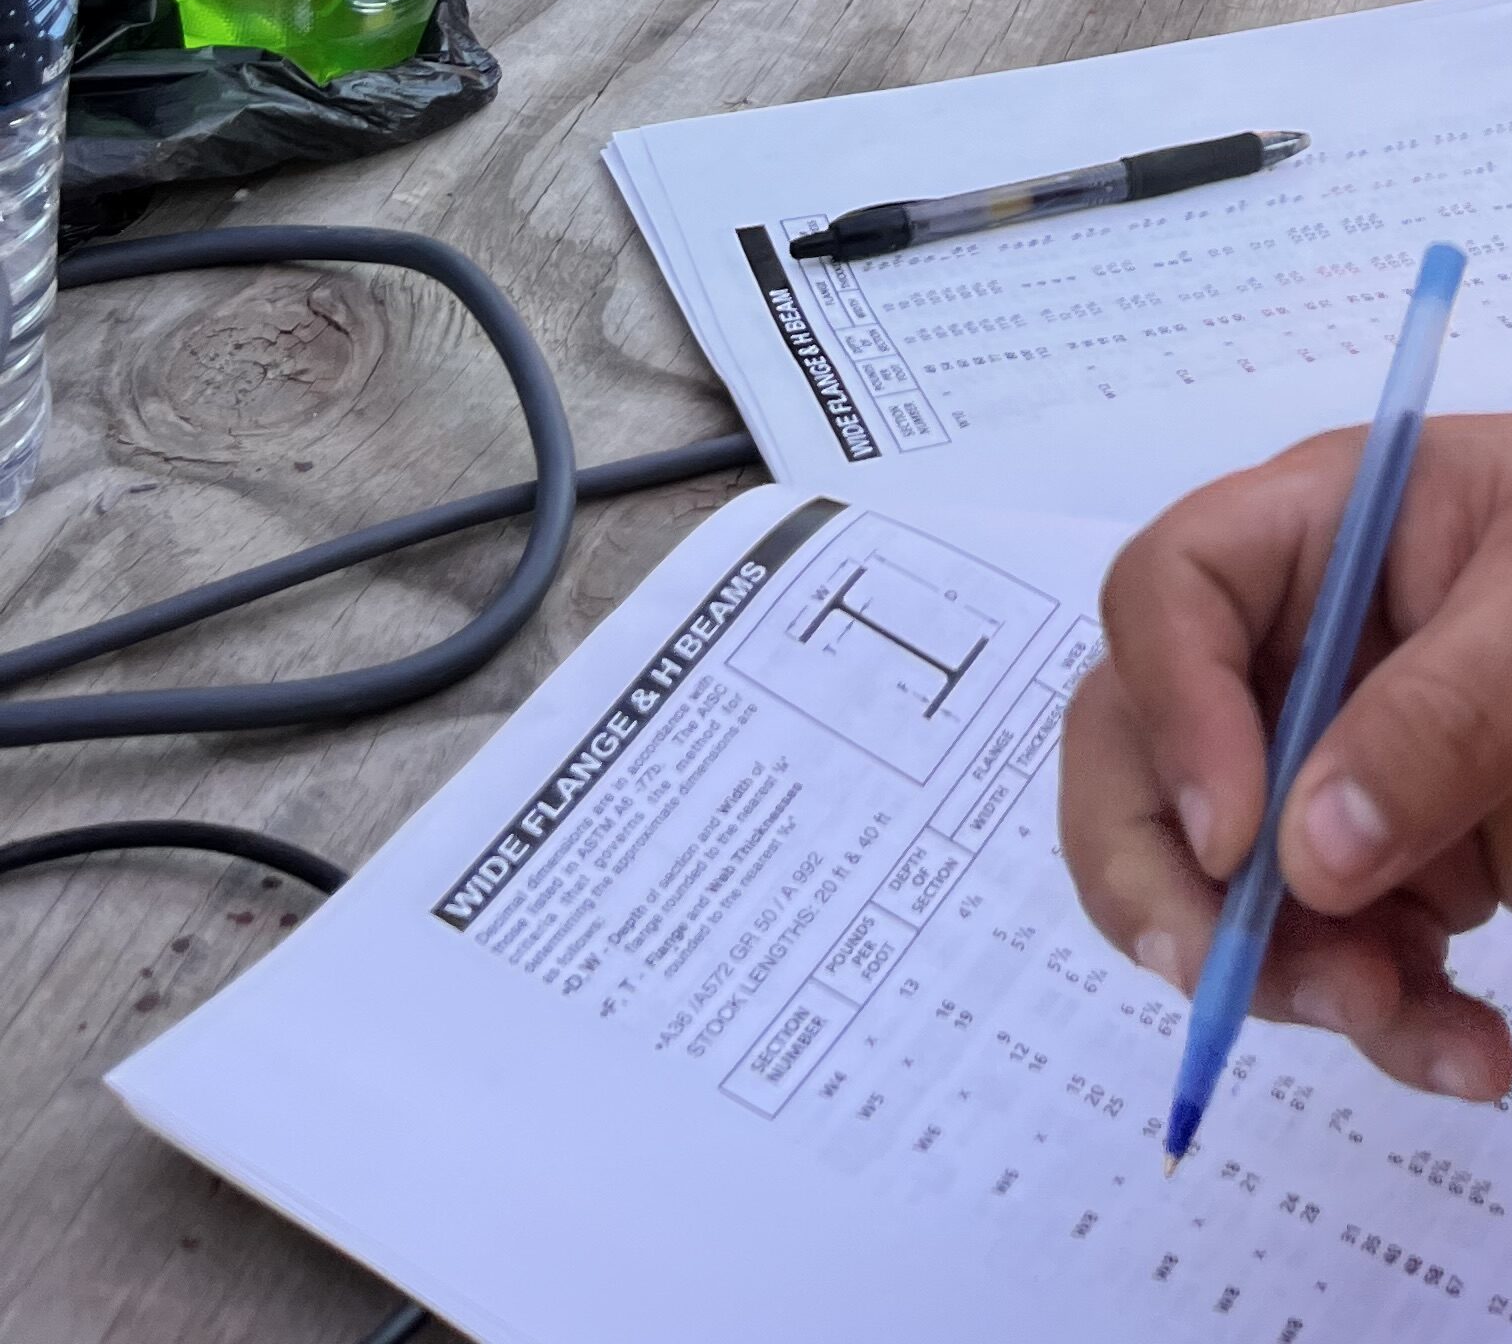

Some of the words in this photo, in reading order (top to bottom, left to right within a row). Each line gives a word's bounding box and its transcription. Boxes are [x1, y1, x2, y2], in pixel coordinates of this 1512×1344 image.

[769, 288, 806, 333] BEAM
[790, 332, 813, 344] H
[798, 344, 819, 357] &
[805, 355, 853, 415] FLANGE
[835, 414, 873, 459] WIDE
[445, 833, 530, 919] WIDE
[522, 710, 638, 836] FLANGE
[630, 689, 660, 713] &
[650, 657, 683, 686] H
[675, 560, 768, 663] BEAMS
[972, 728, 1015, 782] FLANGE
[527, 817, 593, 890] dimensions
[593, 793, 614, 814] are
[627, 704, 689, 775] accordance
[578, 816, 616, 860] ASTM
[671, 720, 698, 745] The
[697, 683, 727, 717] AISC
[594, 813, 644, 869] governs
[647, 781, 671, 804] the
[675, 719, 720, 772] method
[612, 797, 680, 875] approximate
[679, 726, 739, 796] dimensions
[969, 784, 1011, 832] WIDTH
[608, 905, 648, 945] Depth
[646, 888, 659, 904] of
[659, 843, 699, 889] section
[698, 816, 721, 843] and
[716, 778, 754, 814] Width
[751, 761, 765, 776] of
[662, 861, 708, 912] rounded
[704, 846, 720, 860] to
[717, 823, 738, 845] the
[736, 775, 778, 822] nearest
[888, 846, 927, 892] DEPTH
[645, 922, 688, 968] Flange
[687, 896, 710, 921] and
[705, 865, 736, 893] Web
[730, 782, 803, 863] Thicknesses
[911, 856, 959, 914] SECTION
[912, 866, 929, 887] OF
[664, 924, 711, 977] rounded
[708, 910, 723, 923] to
[720, 889, 742, 909] the
[740, 838, 783, 887] nearest
[686, 993, 748, 1057] STOCK
[739, 904, 820, 993] LENGTHS:
[814, 879, 838, 904] 20
[832, 865, 851, 881] ft
[844, 851, 862, 865] &
[858, 826, 879, 849] 40
[873, 811, 892, 826] ft
[729, 932, 760, 961] GR
[753, 909, 777, 932] 50
[792, 851, 824, 884] 992
[899, 978, 920, 996] 13
[1017, 825, 1032, 838] 4
[825, 916, 876, 974] POUNDS
[851, 940, 878, 966] PER
[860, 940, 896, 981] FOOT
[751, 1004, 811, 1074] SECTION
[856, 1091, 885, 1121] W5
[936, 999, 956, 1019] 16
[993, 928, 1007, 941] 5
[954, 1010, 973, 1030] 19
[997, 1031, 1010, 1044] 9
[1010, 1042, 1030, 1062] 12
[1065, 970, 1079, 982] 6
[766, 1015, 828, 1083] NUMBER
[1028, 1052, 1048, 1072] 16
[1066, 1074, 1086, 1093] 15
[1121, 1003, 1135, 1015] 6
[1084, 1084, 1105, 1107] 20
[1103, 1095, 1124, 1117] 25
[1143, 1117, 1162, 1138] 10
